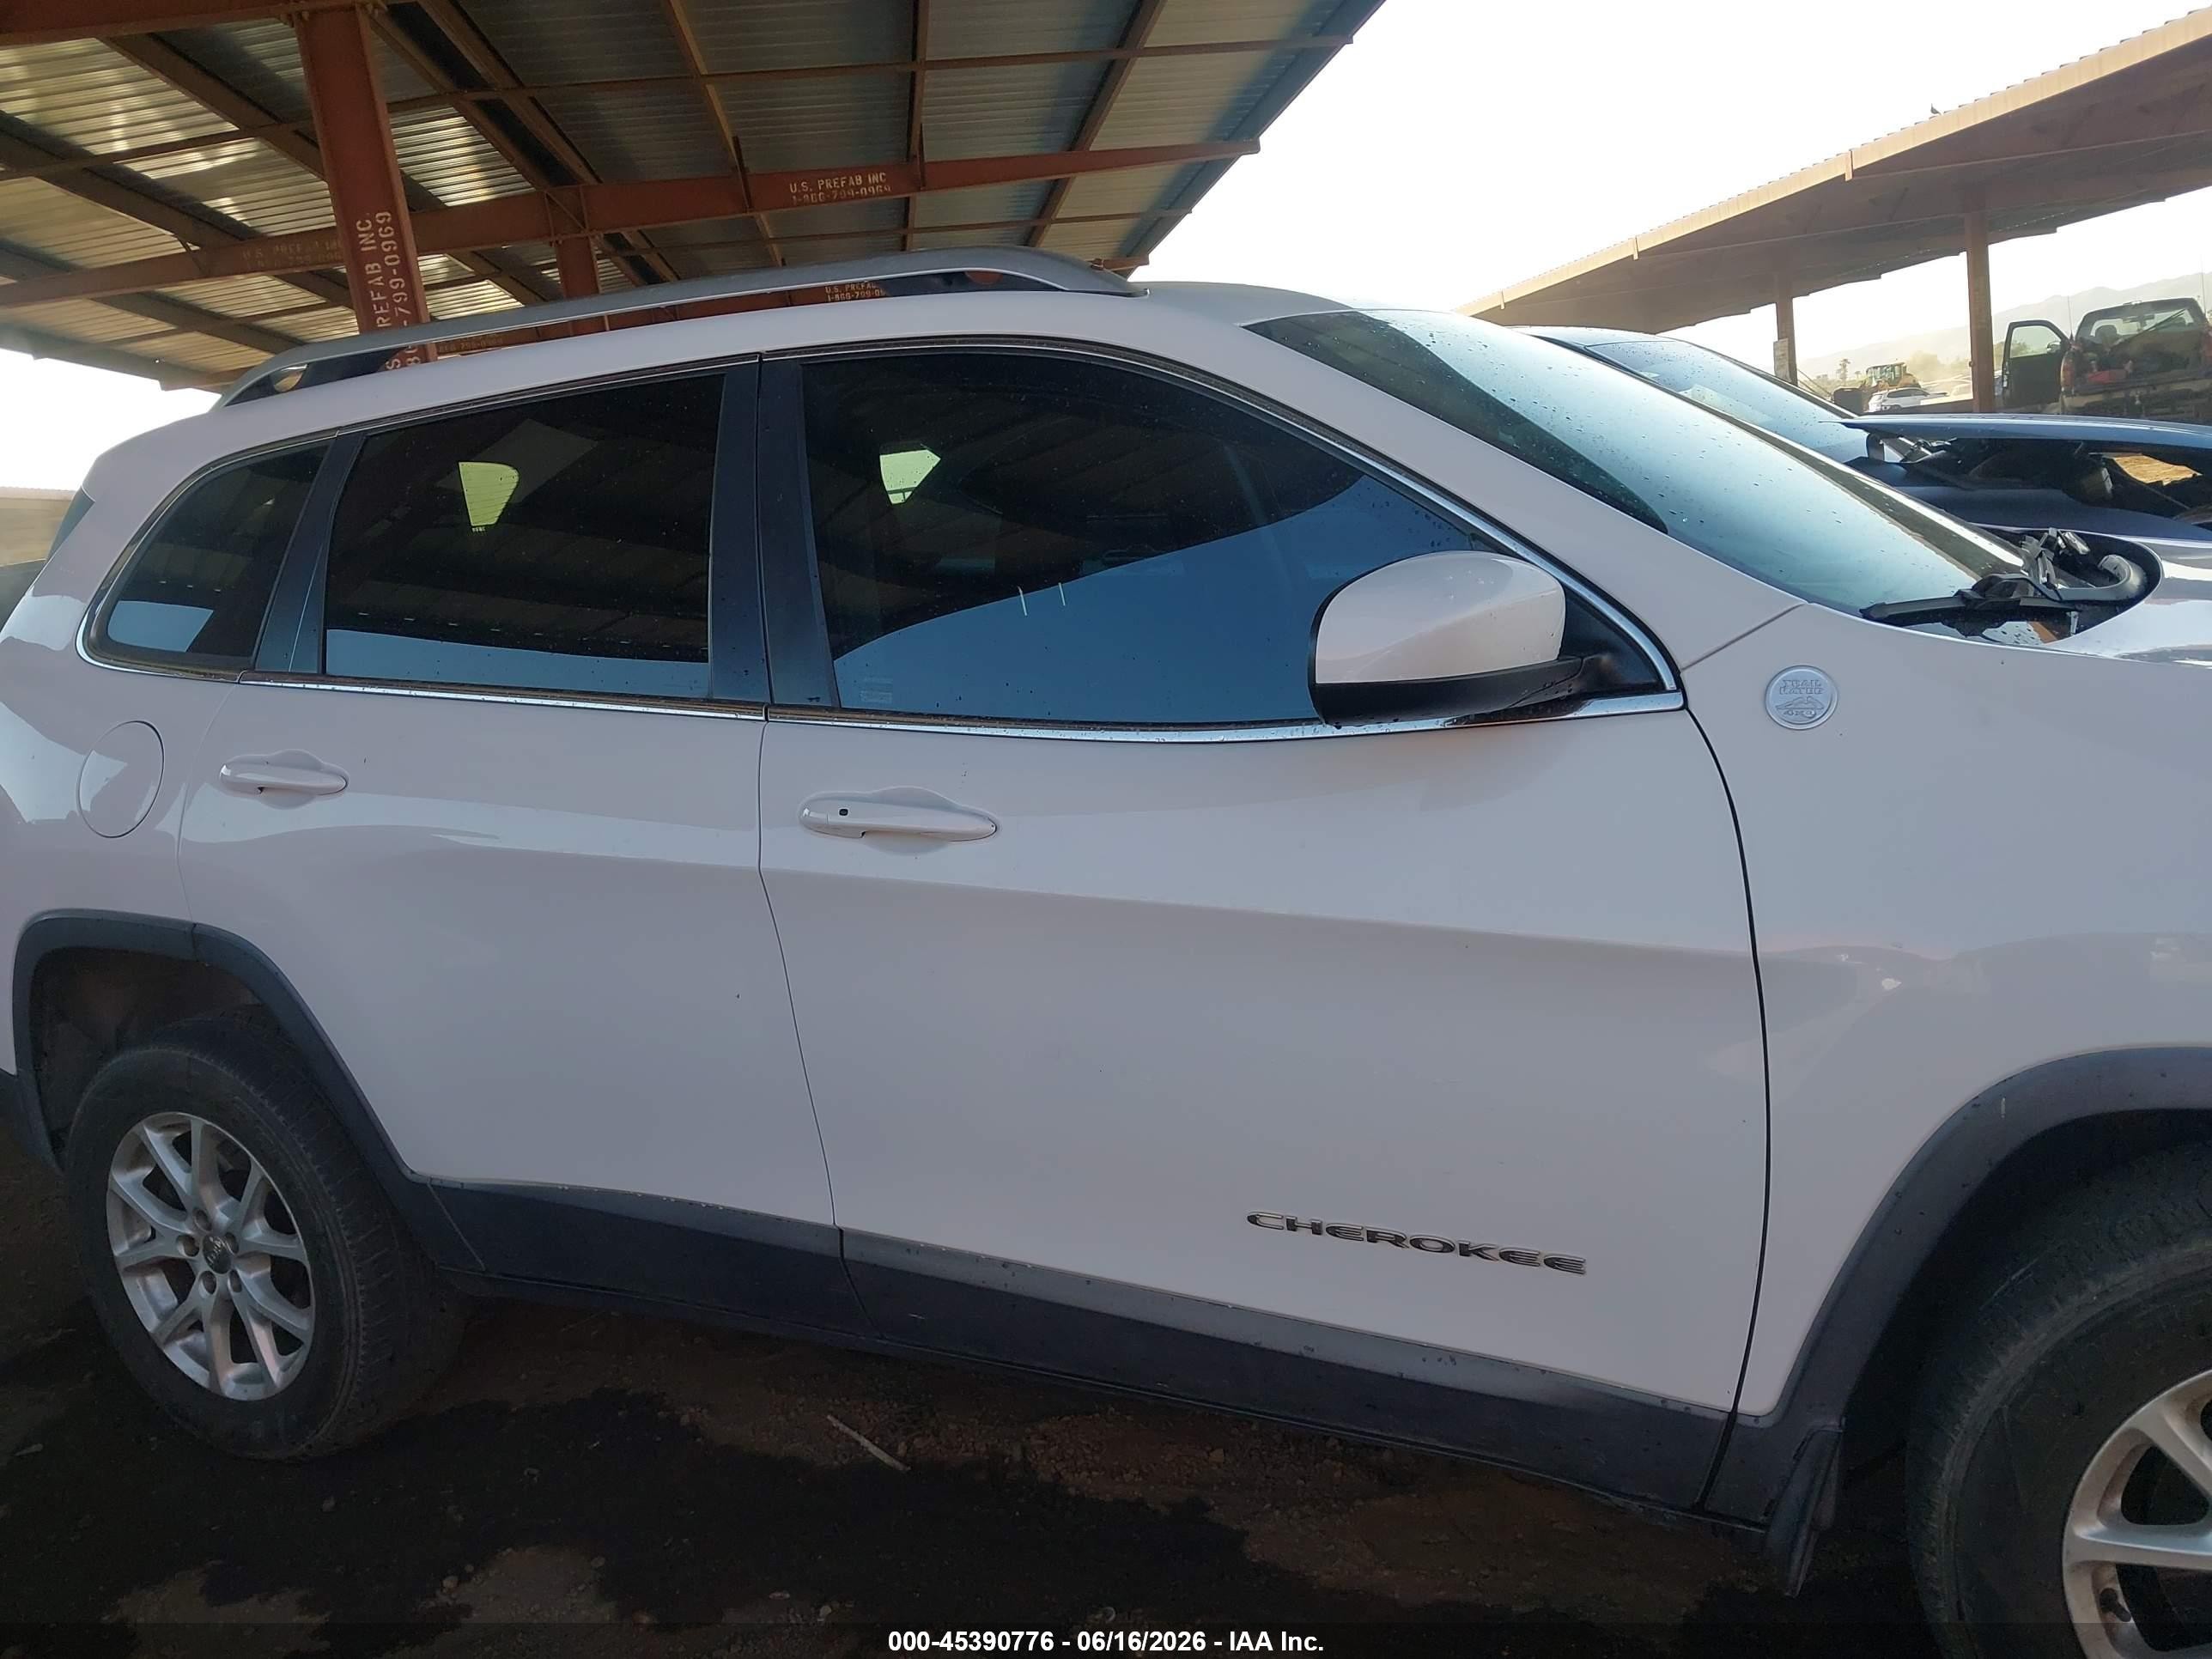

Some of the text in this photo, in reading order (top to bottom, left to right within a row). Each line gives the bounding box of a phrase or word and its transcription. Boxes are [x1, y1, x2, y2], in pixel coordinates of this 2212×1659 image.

[789, 180, 813, 194] U.S.
[817, 174, 863, 191] PREFAB
[364, 263, 392, 328] REFAB
[1245, 1210, 1588, 1276] CHEROKEE
